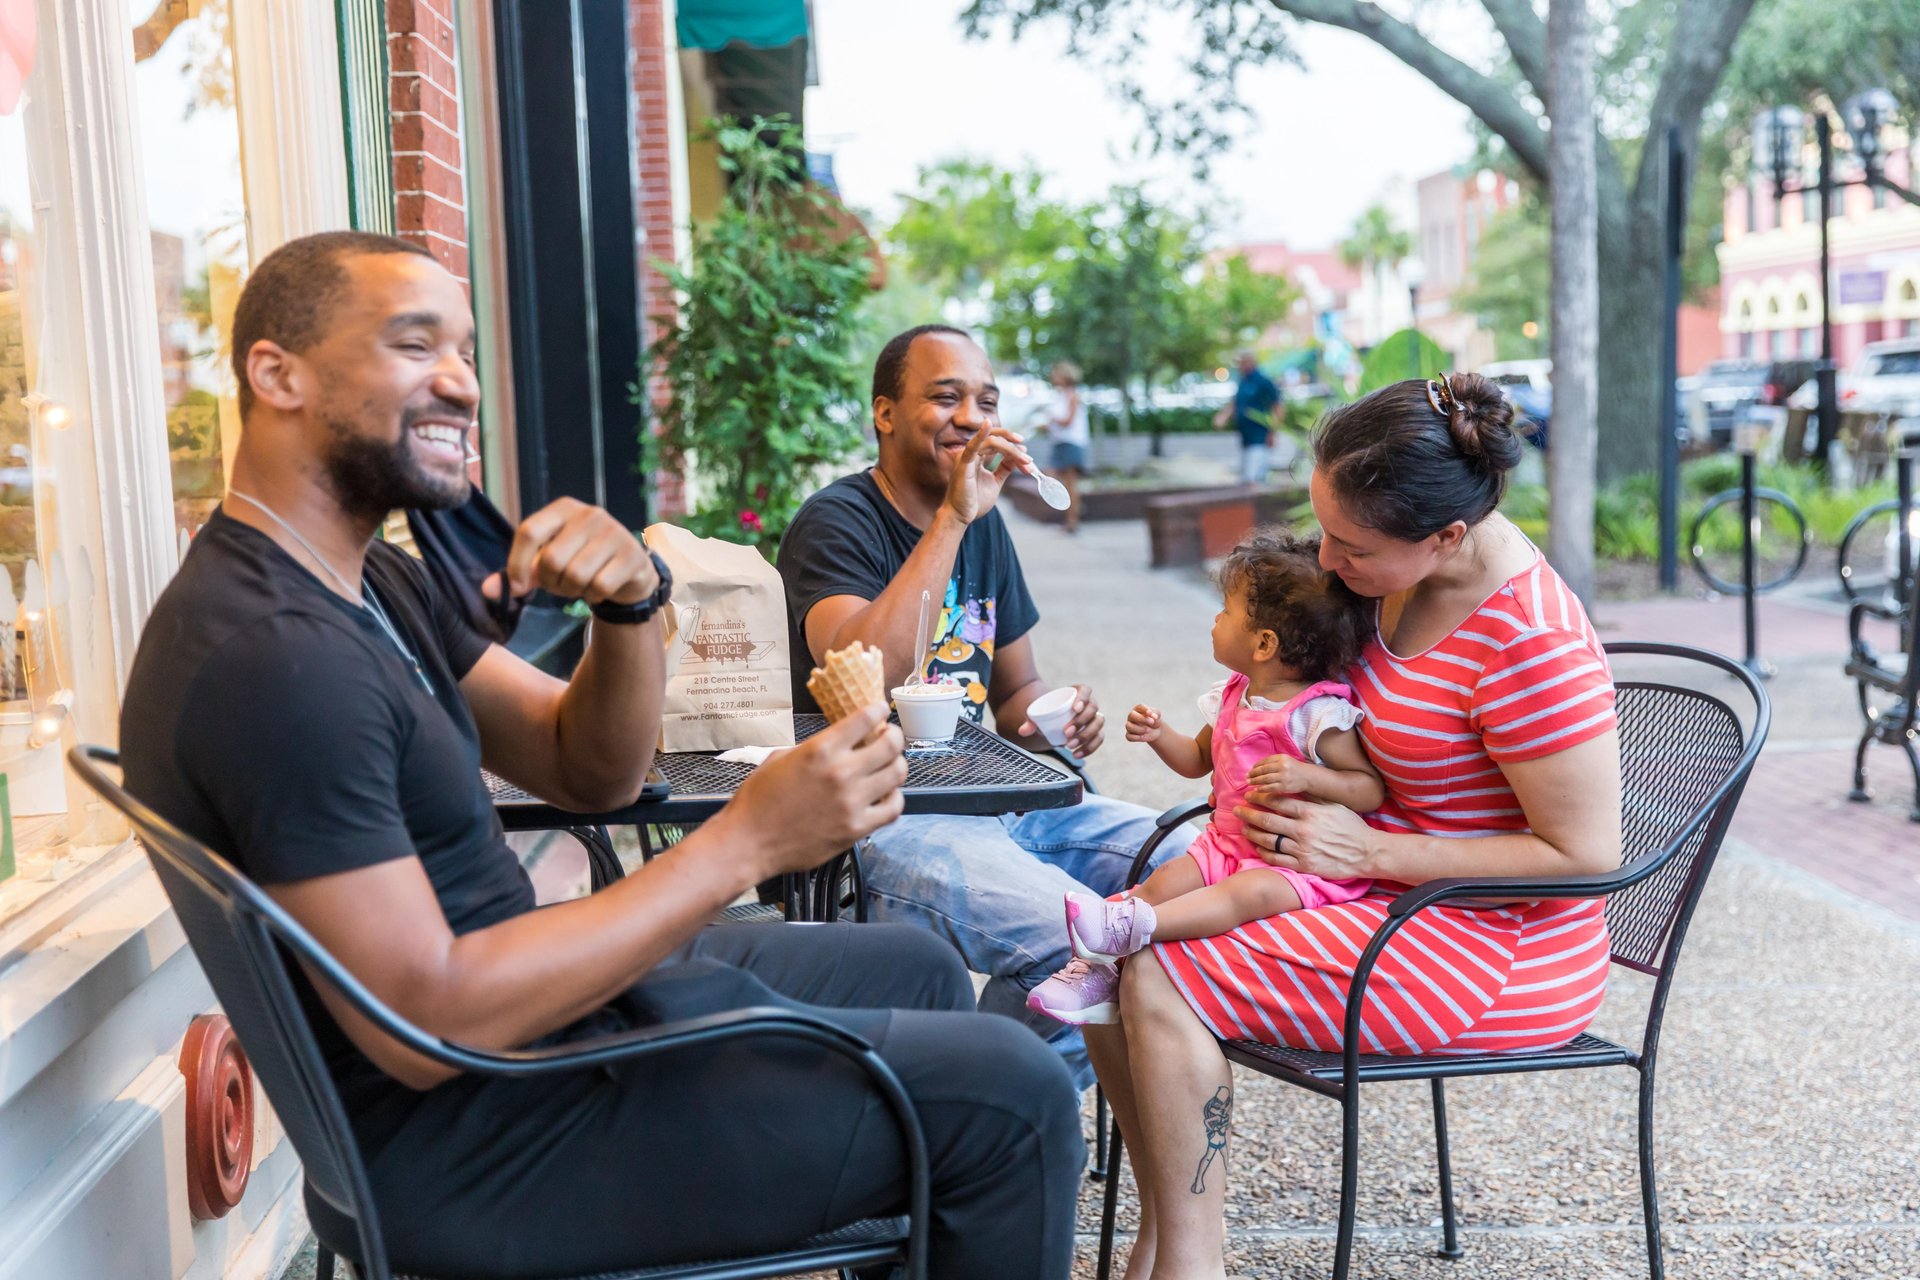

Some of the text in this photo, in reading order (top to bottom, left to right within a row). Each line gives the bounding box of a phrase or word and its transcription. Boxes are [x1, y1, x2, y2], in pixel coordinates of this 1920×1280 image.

[701, 619, 746, 631] fernandina's
[696, 632, 751, 644] FANTASTIC
[707, 644, 743, 655] FUDGE
[711, 676, 736, 684] Centre
[738, 675, 760, 683] Street
[686, 686, 730, 695] Fernandina
[732, 685, 758, 693] Beach,
[703, 701, 754, 710] 904.277.4801
[680, 710, 777, 721] www.FantasticFudge.com
